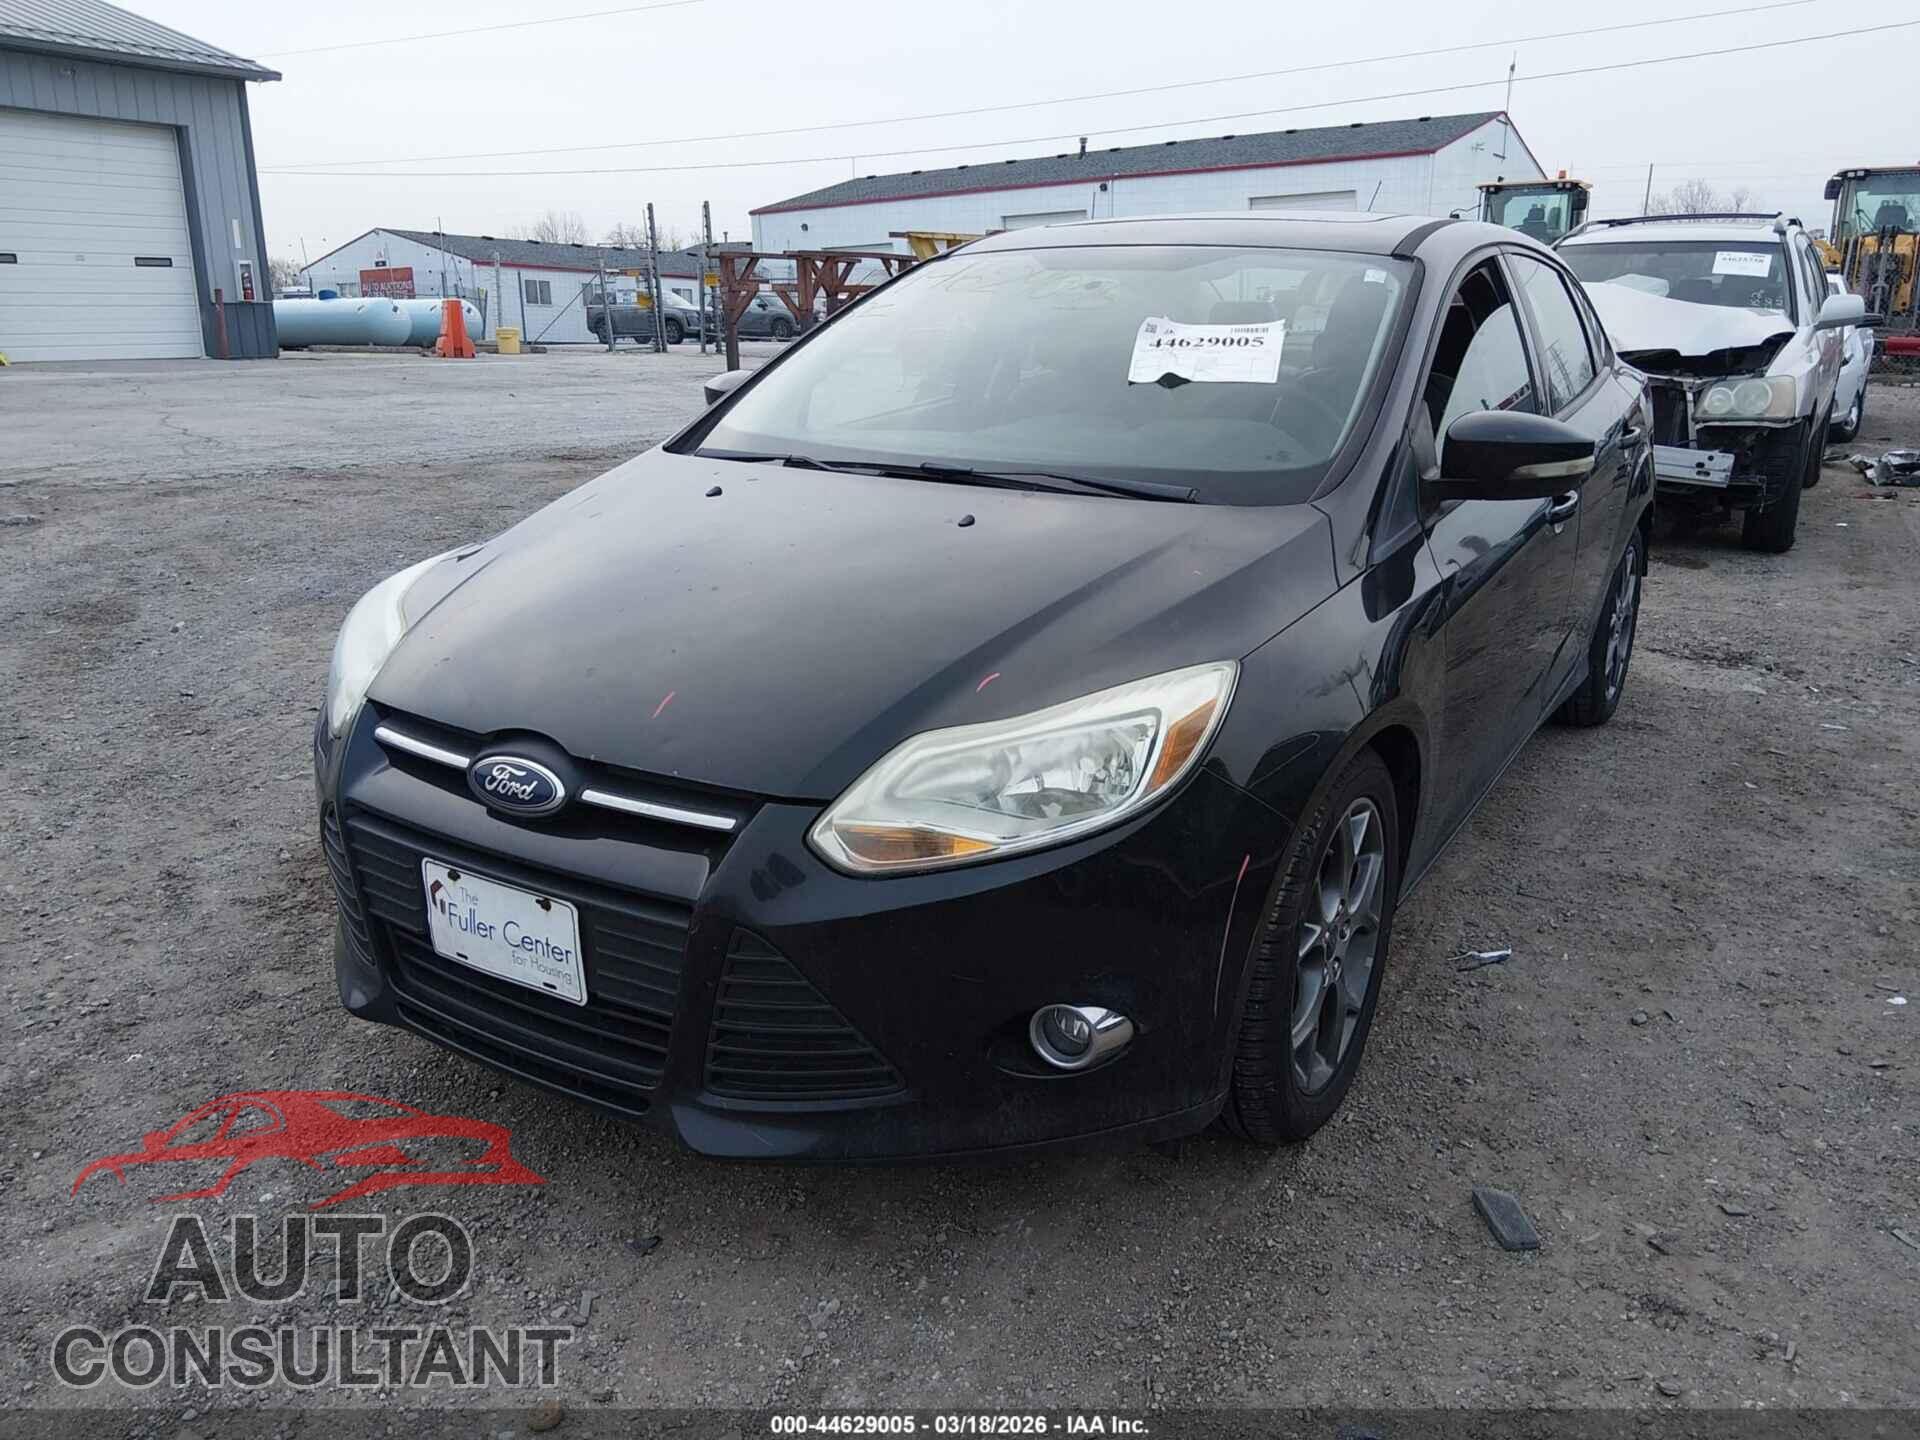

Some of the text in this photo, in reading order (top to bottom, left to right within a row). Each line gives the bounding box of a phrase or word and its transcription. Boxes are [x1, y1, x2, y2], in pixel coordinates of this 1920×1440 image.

[1149, 336, 1265, 348] 44629005
[485, 764, 538, 800] Ford
[459, 887, 479, 906] The
[448, 902, 572, 964] Fuller Center
[512, 951, 572, 985] for Housing
